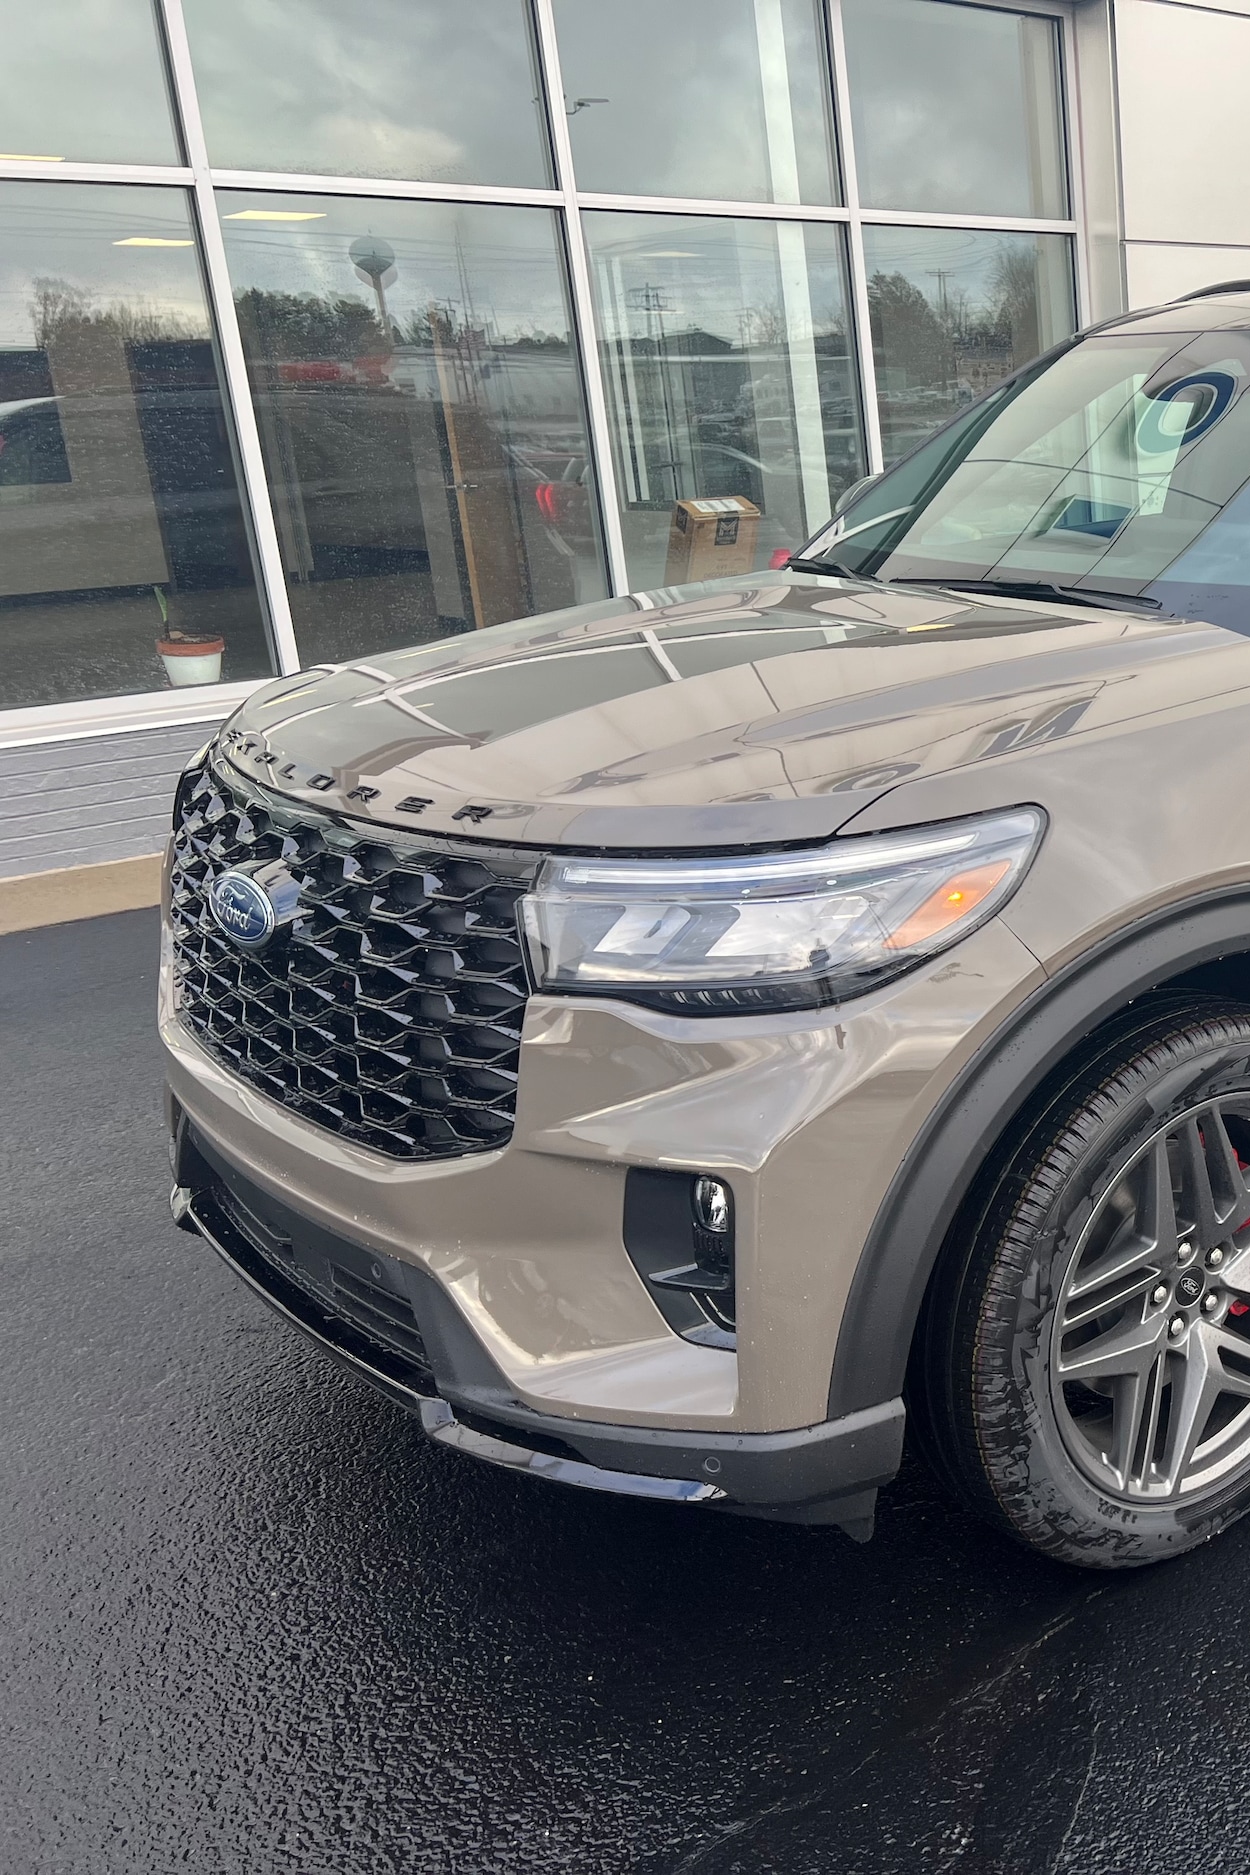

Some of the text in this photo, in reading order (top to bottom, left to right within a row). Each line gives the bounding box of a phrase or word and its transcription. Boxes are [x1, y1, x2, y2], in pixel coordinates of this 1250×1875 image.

[226, 729, 493, 825] EXPLORER
[215, 880, 253, 931] Ford
[1183, 1279, 1199, 1294] Ford
